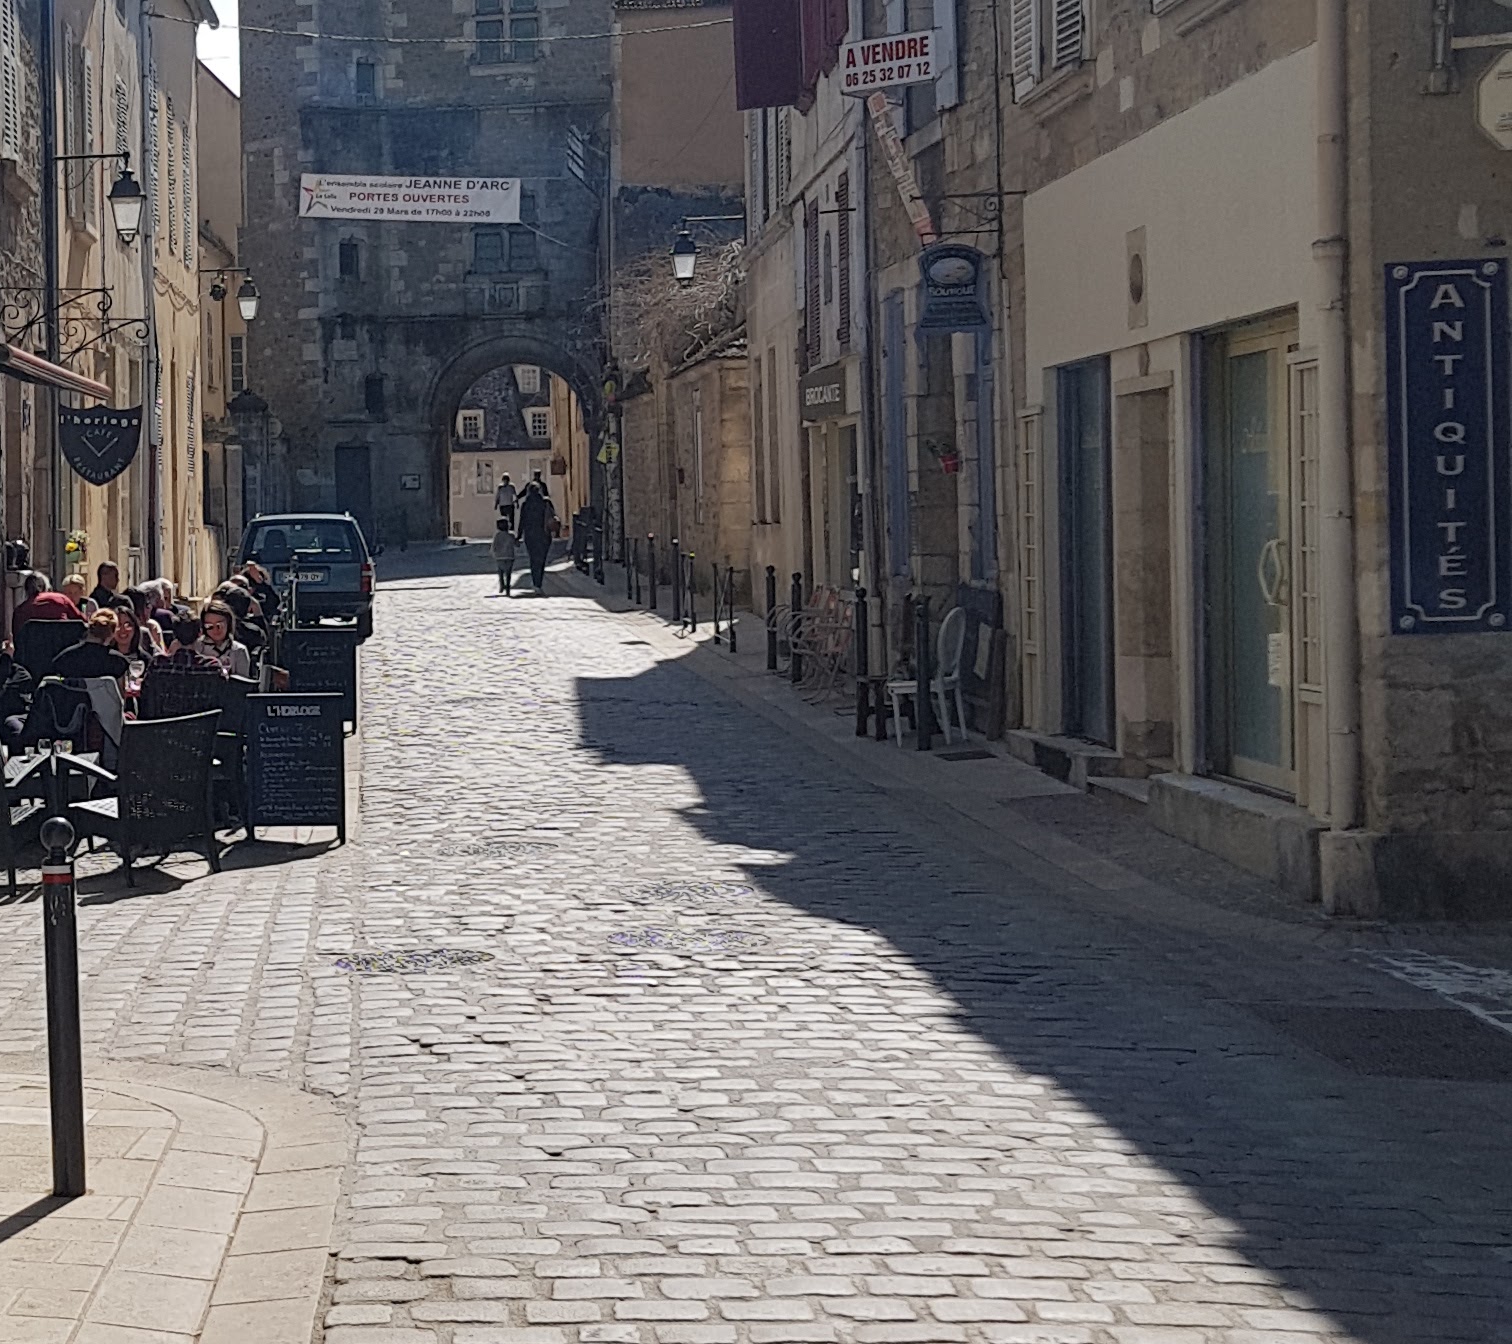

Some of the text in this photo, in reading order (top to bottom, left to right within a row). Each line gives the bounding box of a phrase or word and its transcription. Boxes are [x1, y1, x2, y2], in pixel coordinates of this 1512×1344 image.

[845, 35, 929, 68] A VENDRE
[845, 61, 931, 87] 06 25 32 07 12
[405, 179, 462, 190] JEANNE
[466, 180, 510, 191] D'ARC
[349, 192, 470, 204] PORTES OUVERTES
[330, 205, 371, 214] Vendredi
[387, 208, 409, 216] Mars
[411, 208, 422, 216] de
[805, 383, 840, 406] BROCANTE
[60, 415, 139, 428] l'horloge
[1429, 282, 1468, 611] ANTIQUITÉS
[73, 456, 125, 480] RESTAURANT
